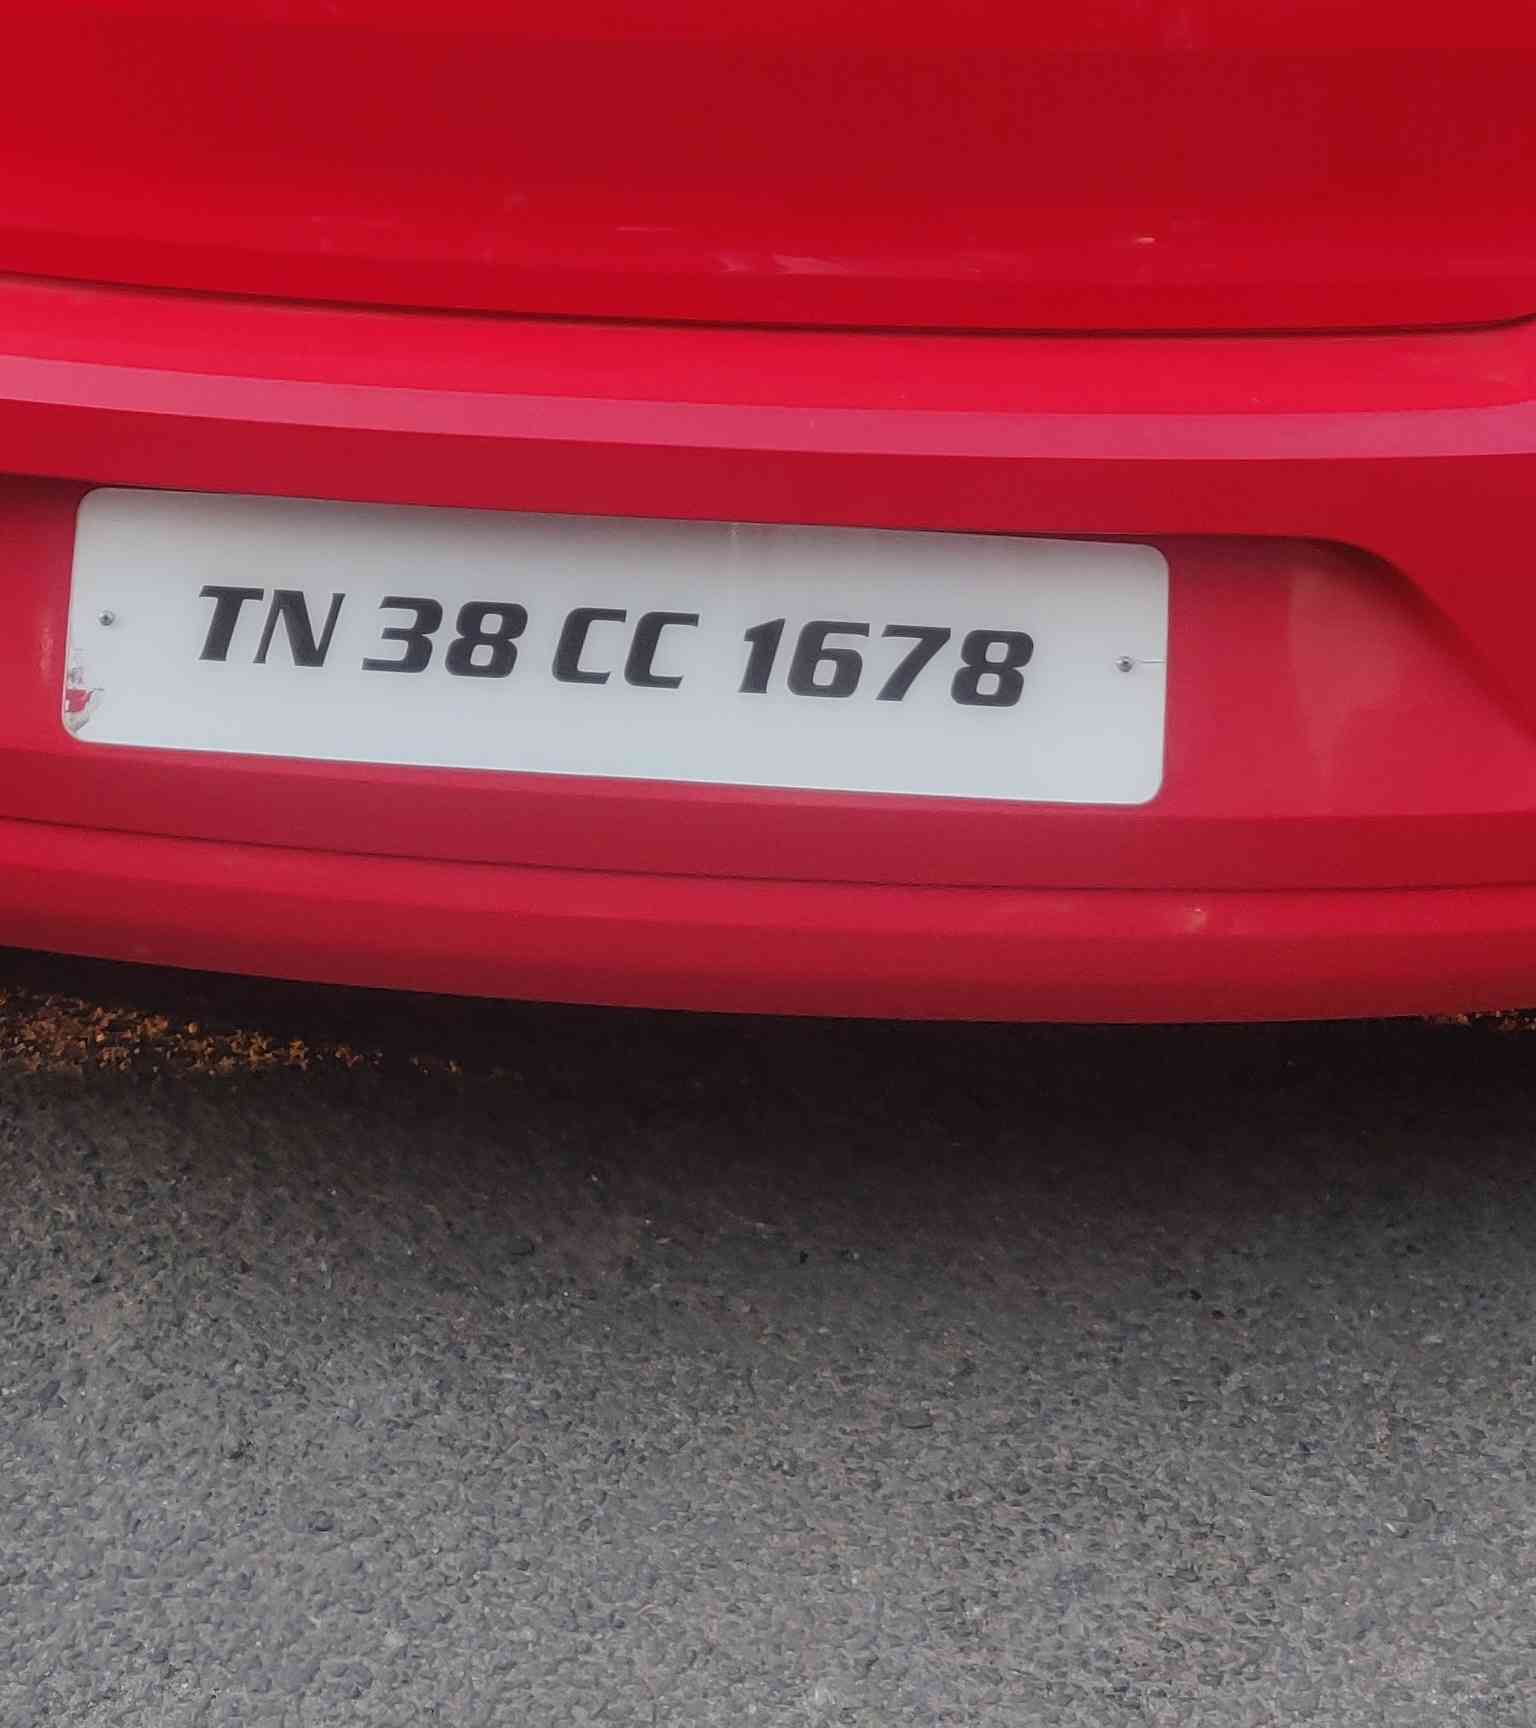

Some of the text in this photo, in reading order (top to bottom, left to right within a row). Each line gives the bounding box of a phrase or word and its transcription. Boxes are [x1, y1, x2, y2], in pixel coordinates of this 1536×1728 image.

[199, 585, 1035, 707] TN 38 CC 1678
